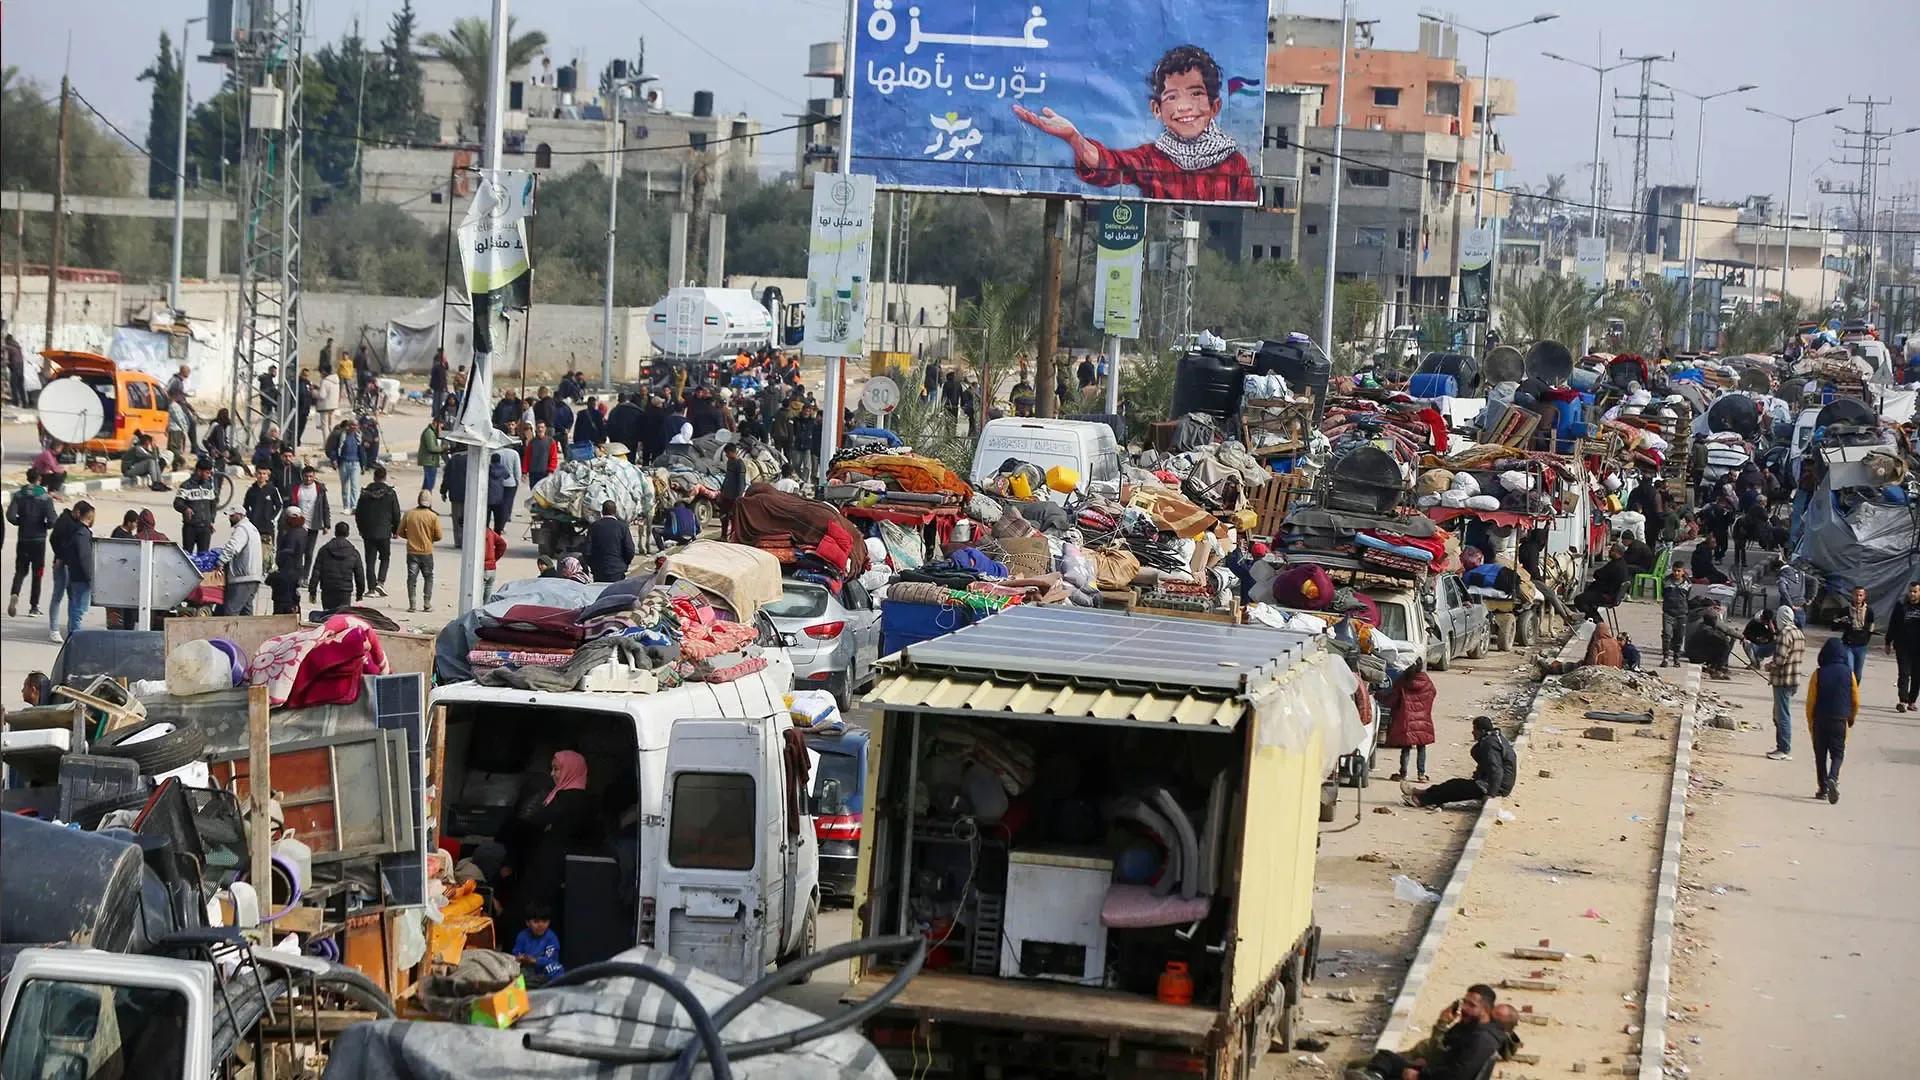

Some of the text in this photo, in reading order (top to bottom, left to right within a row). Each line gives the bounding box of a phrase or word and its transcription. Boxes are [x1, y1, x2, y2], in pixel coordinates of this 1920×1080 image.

[867, 53, 953, 96] بأهلها
[820, 216, 831, 226] لها
[856, 219, 862, 227] لا
[871, 388, 889, 403] 80
